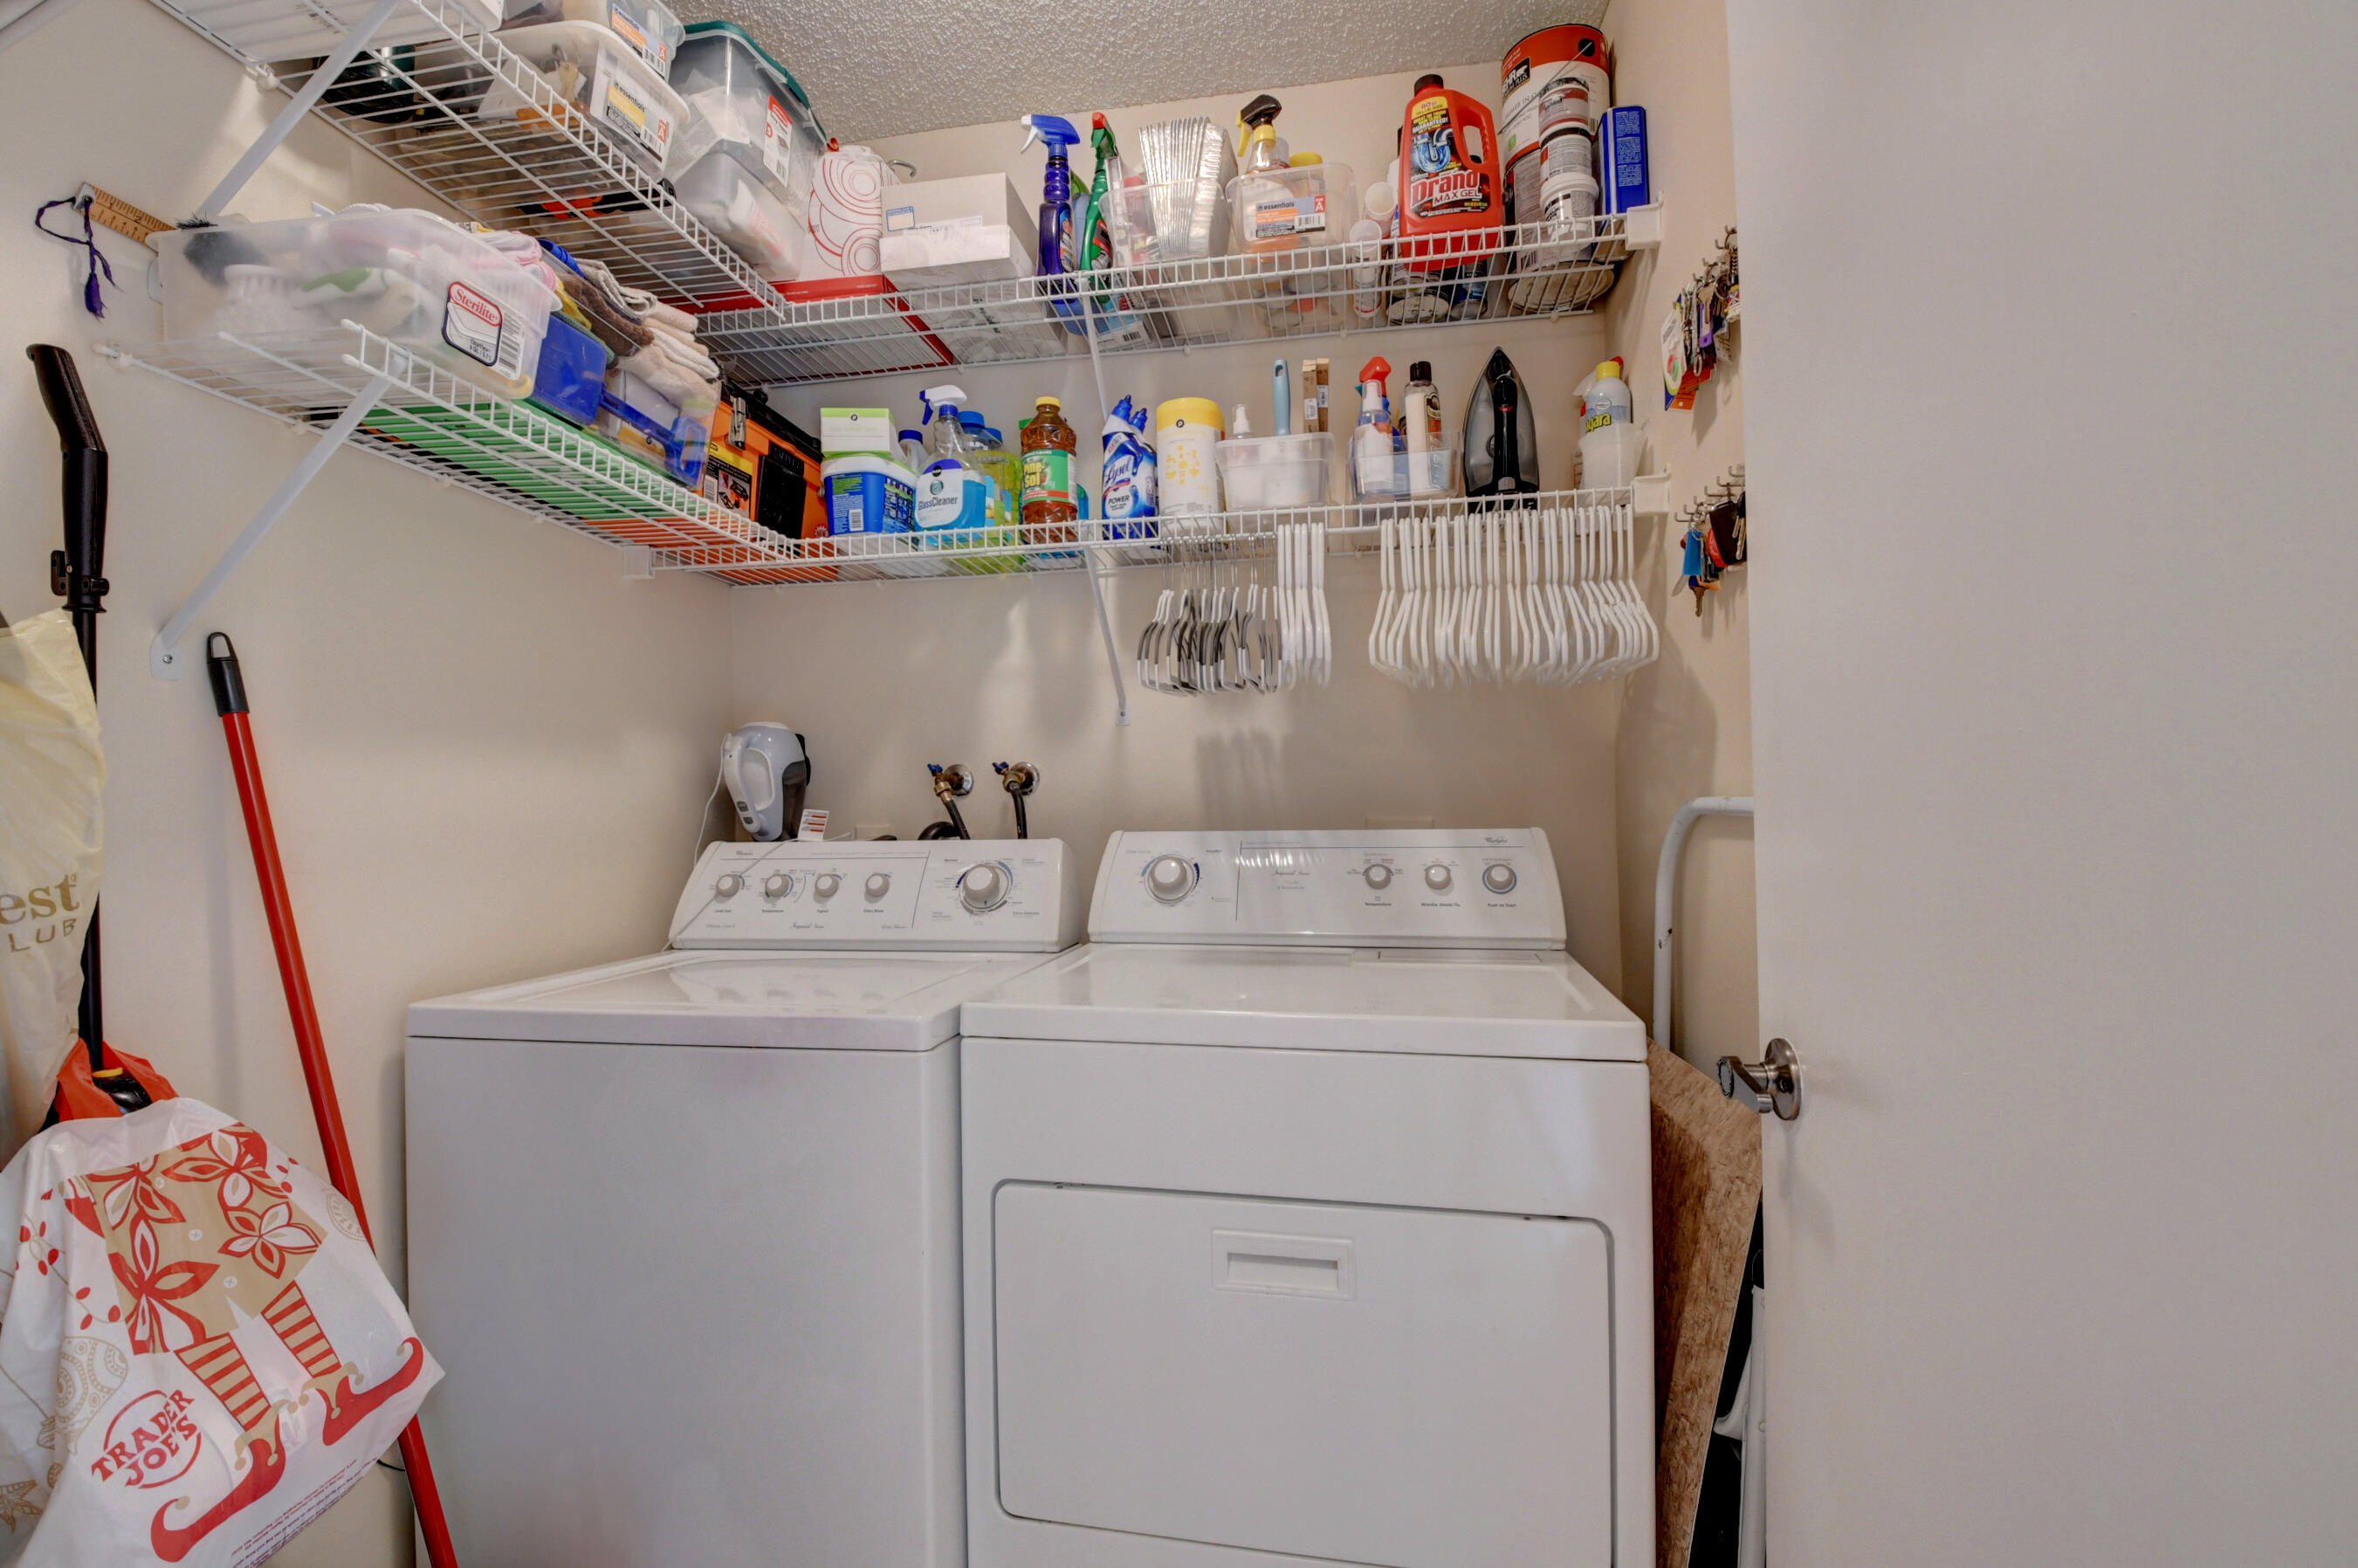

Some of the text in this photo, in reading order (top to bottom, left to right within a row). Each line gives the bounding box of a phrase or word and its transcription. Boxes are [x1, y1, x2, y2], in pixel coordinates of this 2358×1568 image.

[619, 86, 646, 113] essentials
[1411, 171, 1479, 206] Drano
[1434, 189, 1481, 204] MAX GEL
[1263, 201, 1295, 210] essentials
[454, 288, 496, 321] Sterilite
[918, 497, 959, 511] GlassCleaner
[1108, 495, 1131, 505] POWER
[91, 1390, 196, 1482] TRADER
[125, 1414, 197, 1487] JOE'S
